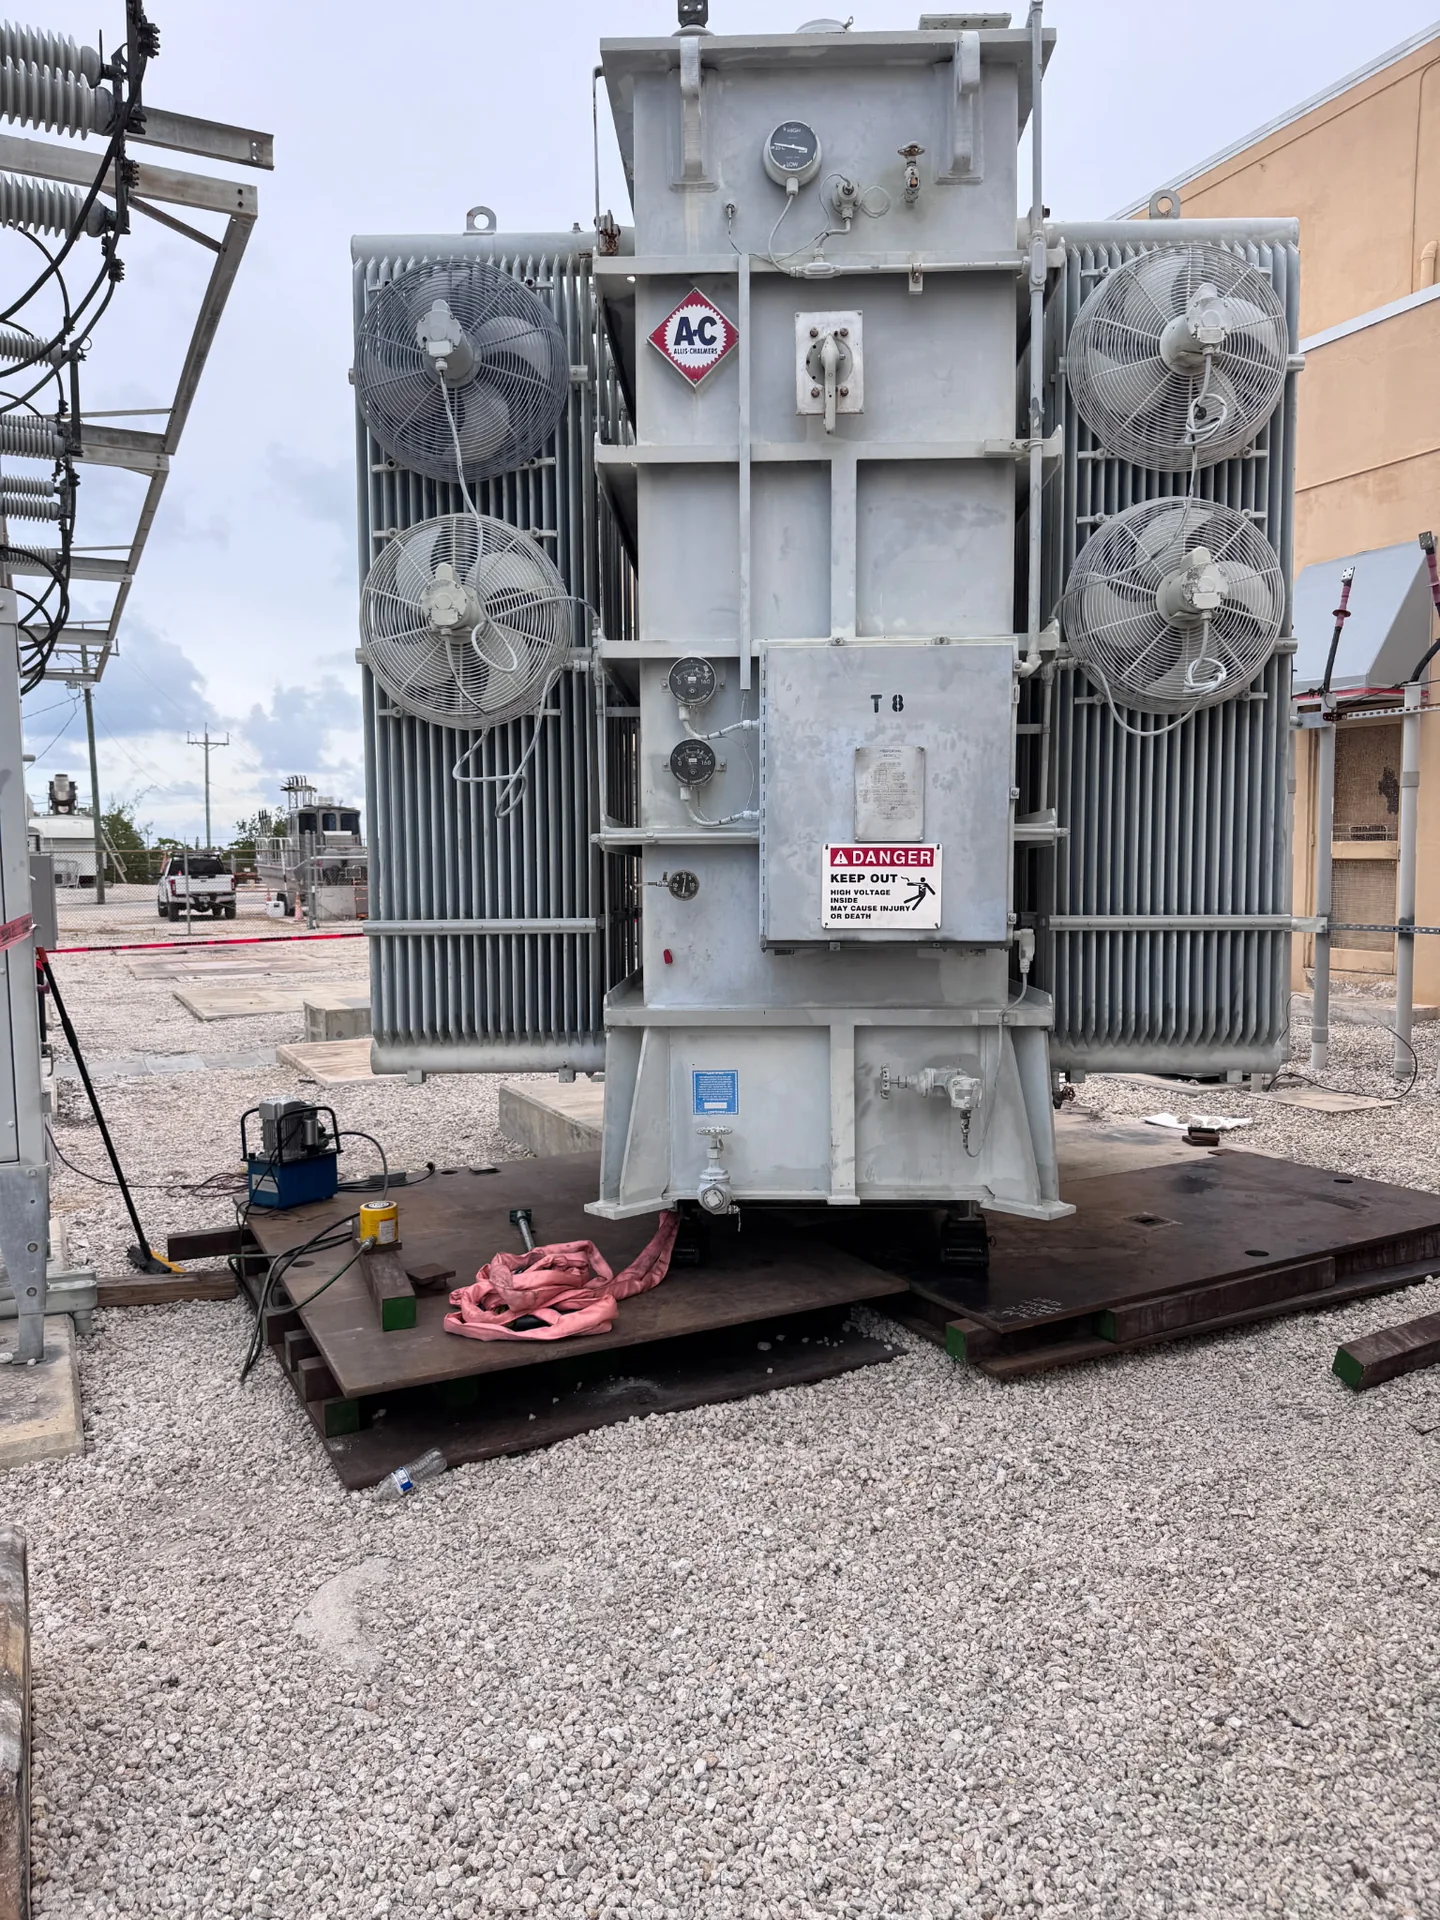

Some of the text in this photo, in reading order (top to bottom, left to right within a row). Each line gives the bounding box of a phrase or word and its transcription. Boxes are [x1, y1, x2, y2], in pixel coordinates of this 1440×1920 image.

[870, 694, 904, 713] T 8
[852, 850, 931, 865] DANGER
[830, 874, 898, 883] KEEP OUT
